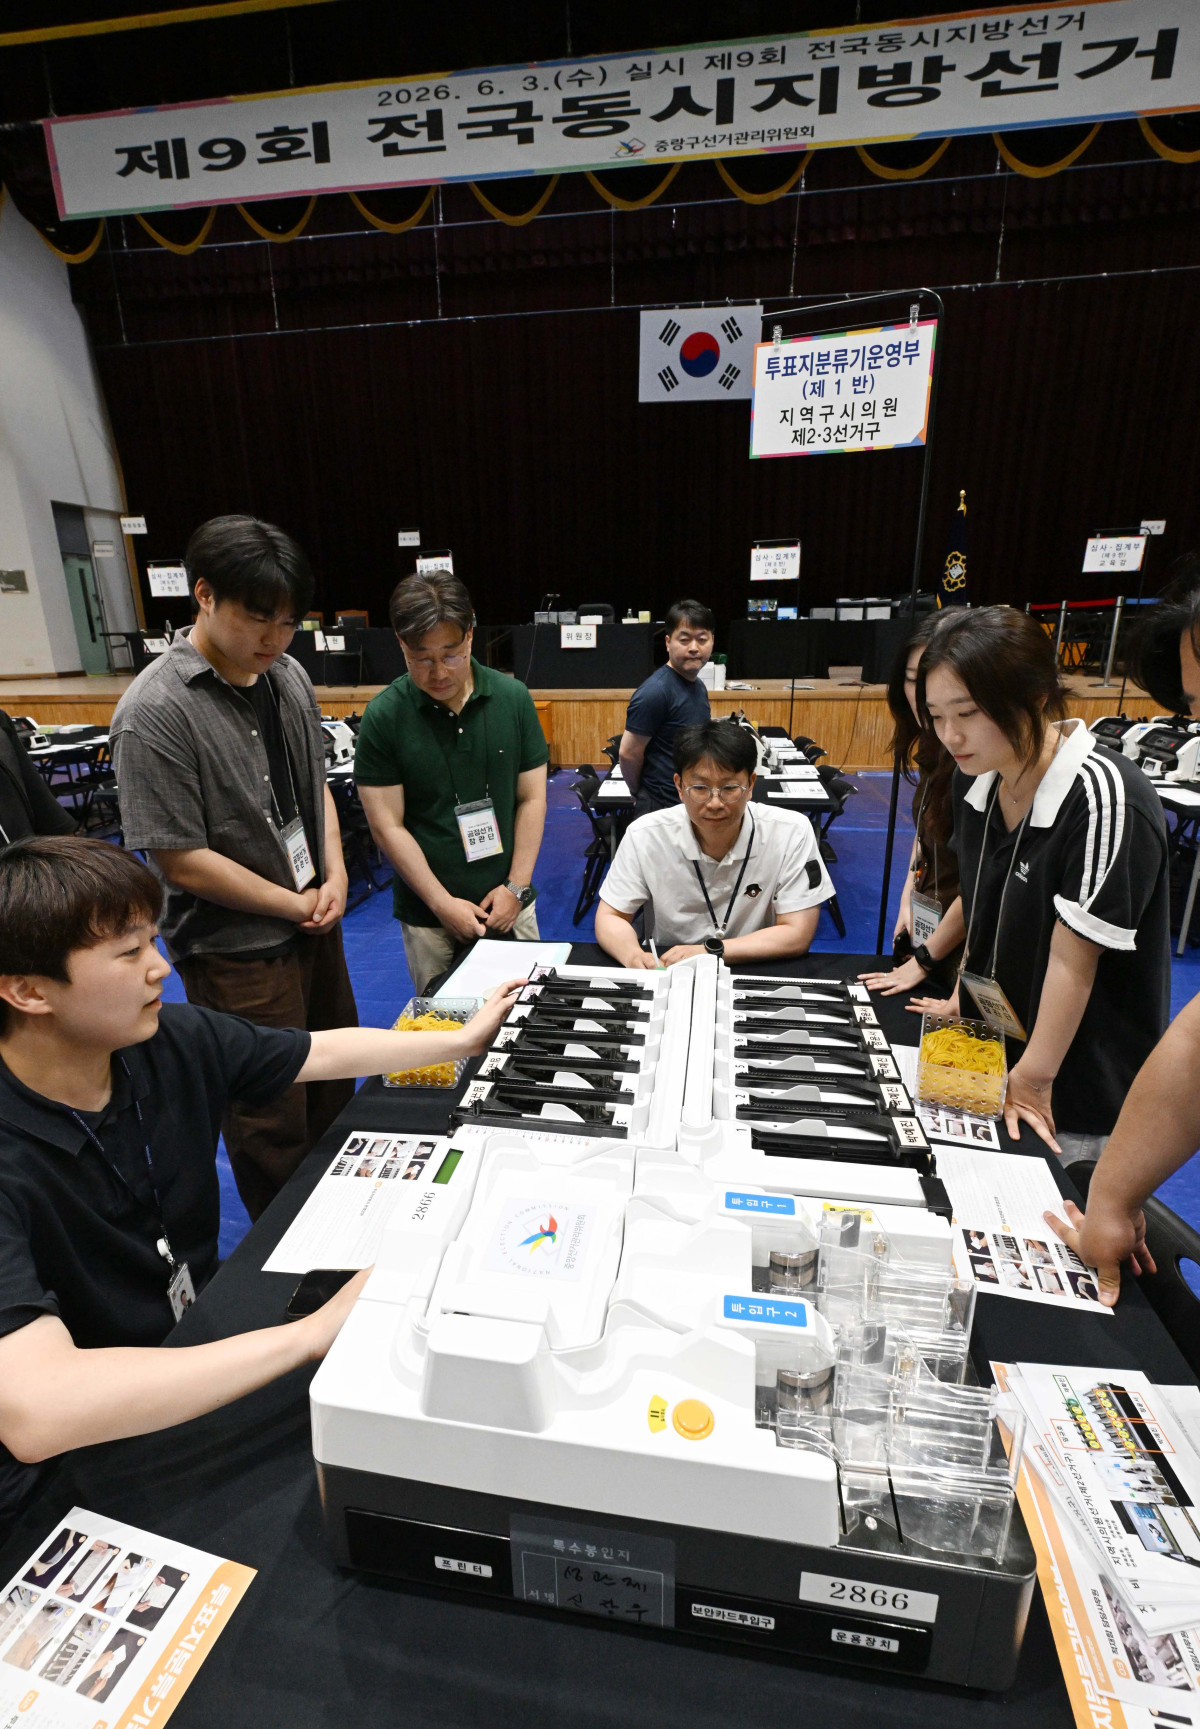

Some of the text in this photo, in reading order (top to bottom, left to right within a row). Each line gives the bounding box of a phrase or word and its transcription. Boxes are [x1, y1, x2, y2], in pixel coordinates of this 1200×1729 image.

[376, 11, 1086, 107] 2026. 6. 3.(수) 실시 제9회 전국동시지방선거
[114, 27, 1180, 180] 제9회 전국동시지방선거
[655, 126, 816, 153] 중랑구선거관리위원회
[765, 340, 920, 381] 투표지분류기운영부
[802, 373, 875, 400] (제 1 반)
[791, 422, 881, 446] 제2·3선거구
[566, 632, 592, 641] 위원장
[899, 1121, 919, 1143] 박예진
[411, 1191, 436, 1221] 2866
[731, 1197, 774, 1209] 투입구
[731, 1302, 781, 1318] 투입구
[552, 1538, 630, 1562] 특수봉인지
[442, 1559, 483, 1575] 프린터
[829, 1581, 910, 1611] 2866
[692, 1605, 773, 1628] 보안카드투입구
[836, 1631, 891, 1650] 운용장치
